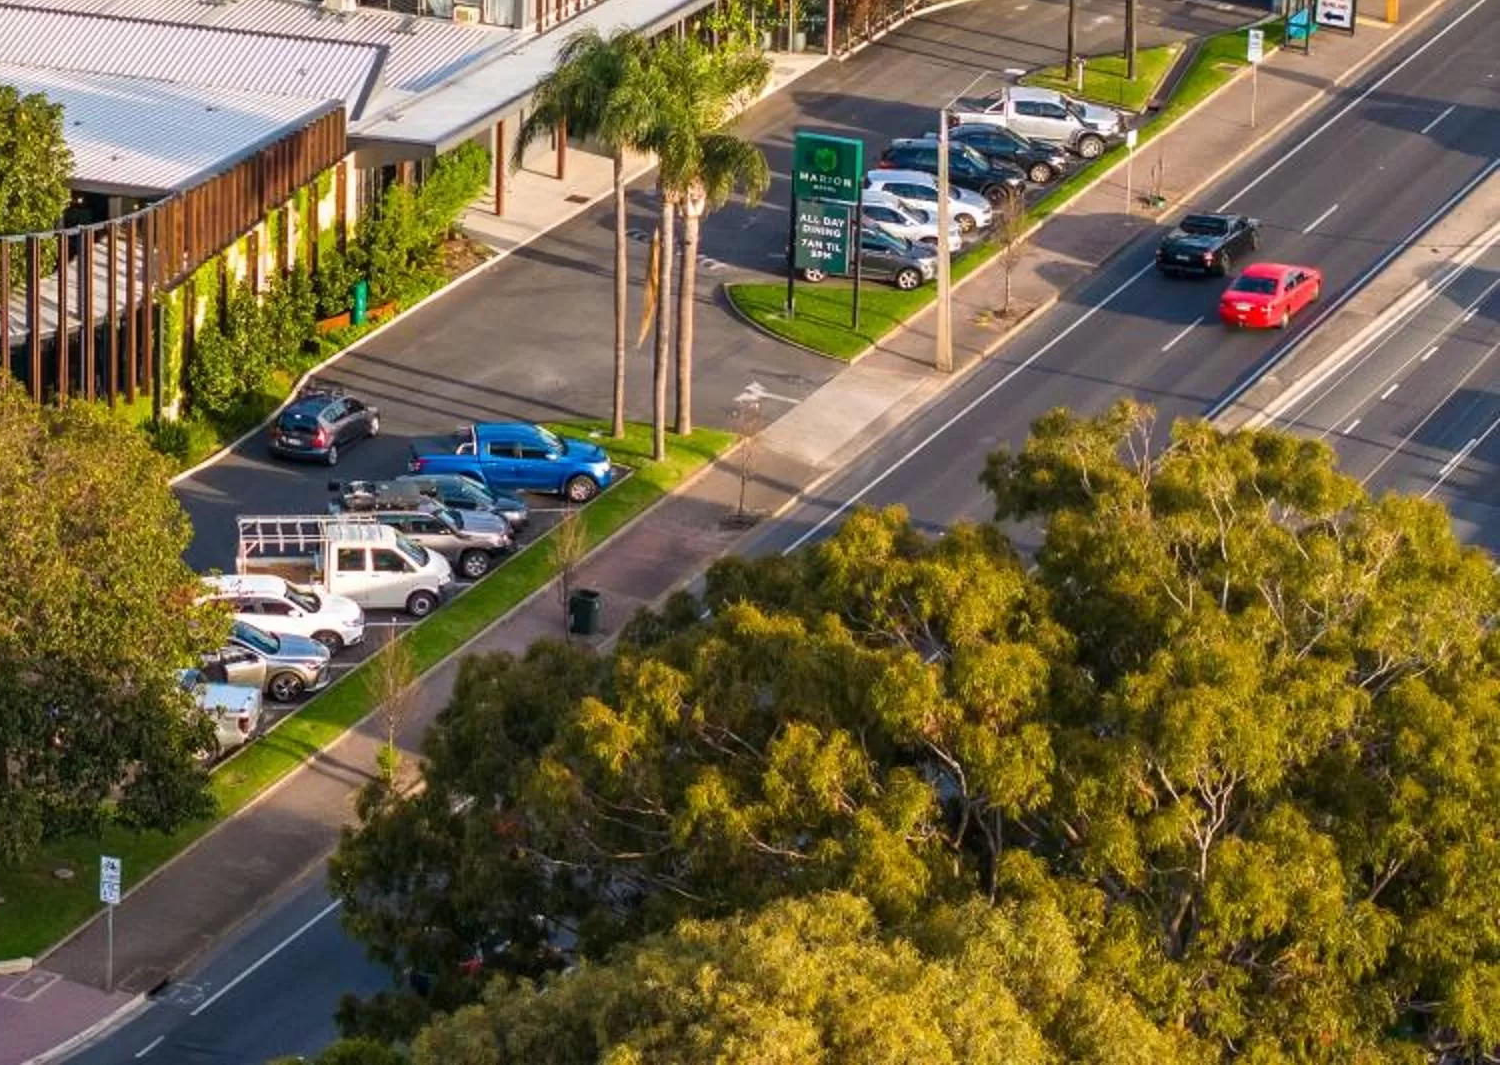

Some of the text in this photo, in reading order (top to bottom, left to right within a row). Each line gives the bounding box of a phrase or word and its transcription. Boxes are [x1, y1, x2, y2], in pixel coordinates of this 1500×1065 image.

[799, 172, 853, 188] MARION
[799, 213, 845, 228] ALL DAY
[802, 224, 842, 238] DINING
[800, 238, 842, 253] 7AM TIL
